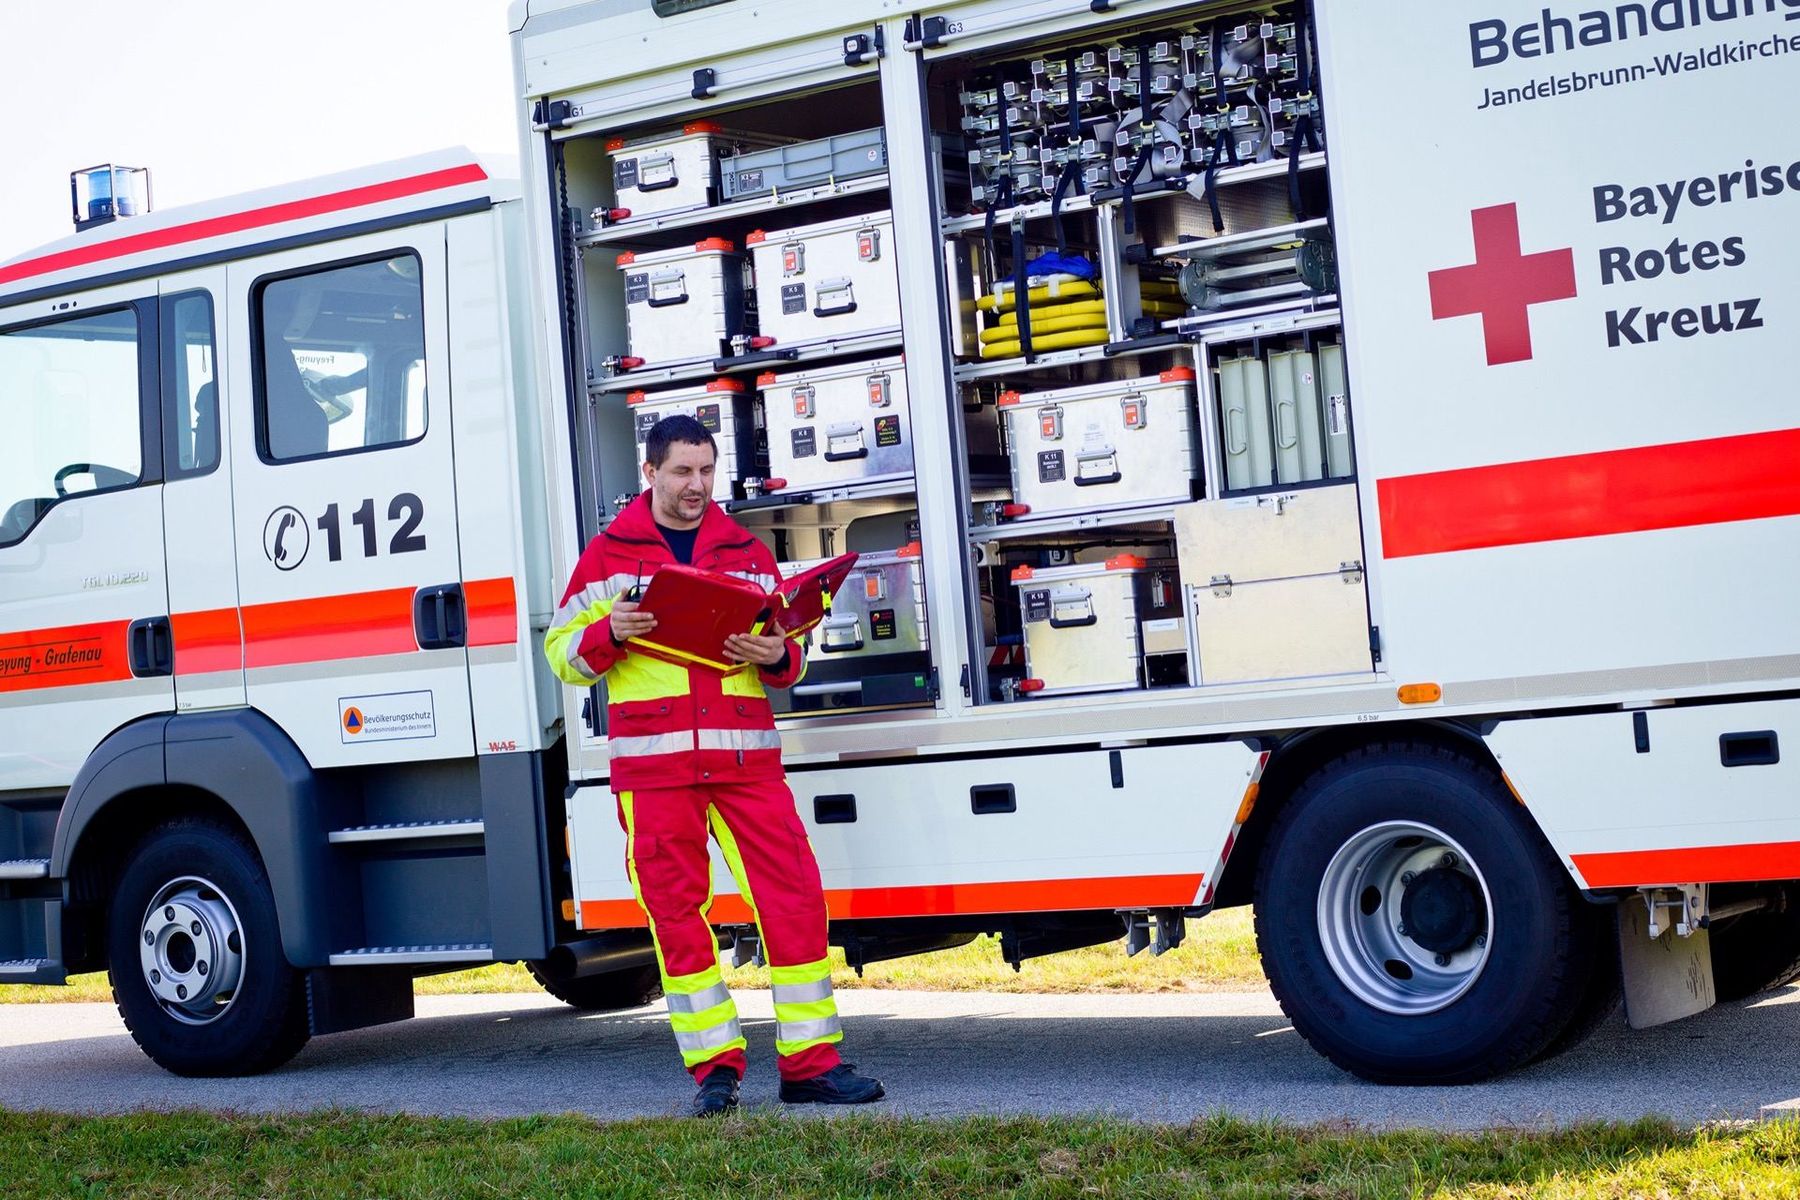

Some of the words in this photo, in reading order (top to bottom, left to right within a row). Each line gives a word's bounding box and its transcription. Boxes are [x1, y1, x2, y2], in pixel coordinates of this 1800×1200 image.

[948, 22, 963, 34] G3
[571, 105, 584, 118] G1
[1599, 236, 1746, 285] Rotes
[1605, 298, 1764, 348] Kreuz
[317, 492, 427, 562] 112
[44, 645, 102, 666] Grafenau
[364, 712, 431, 724] Bevölkerungsschutz
[489, 740, 516, 752] WAS
